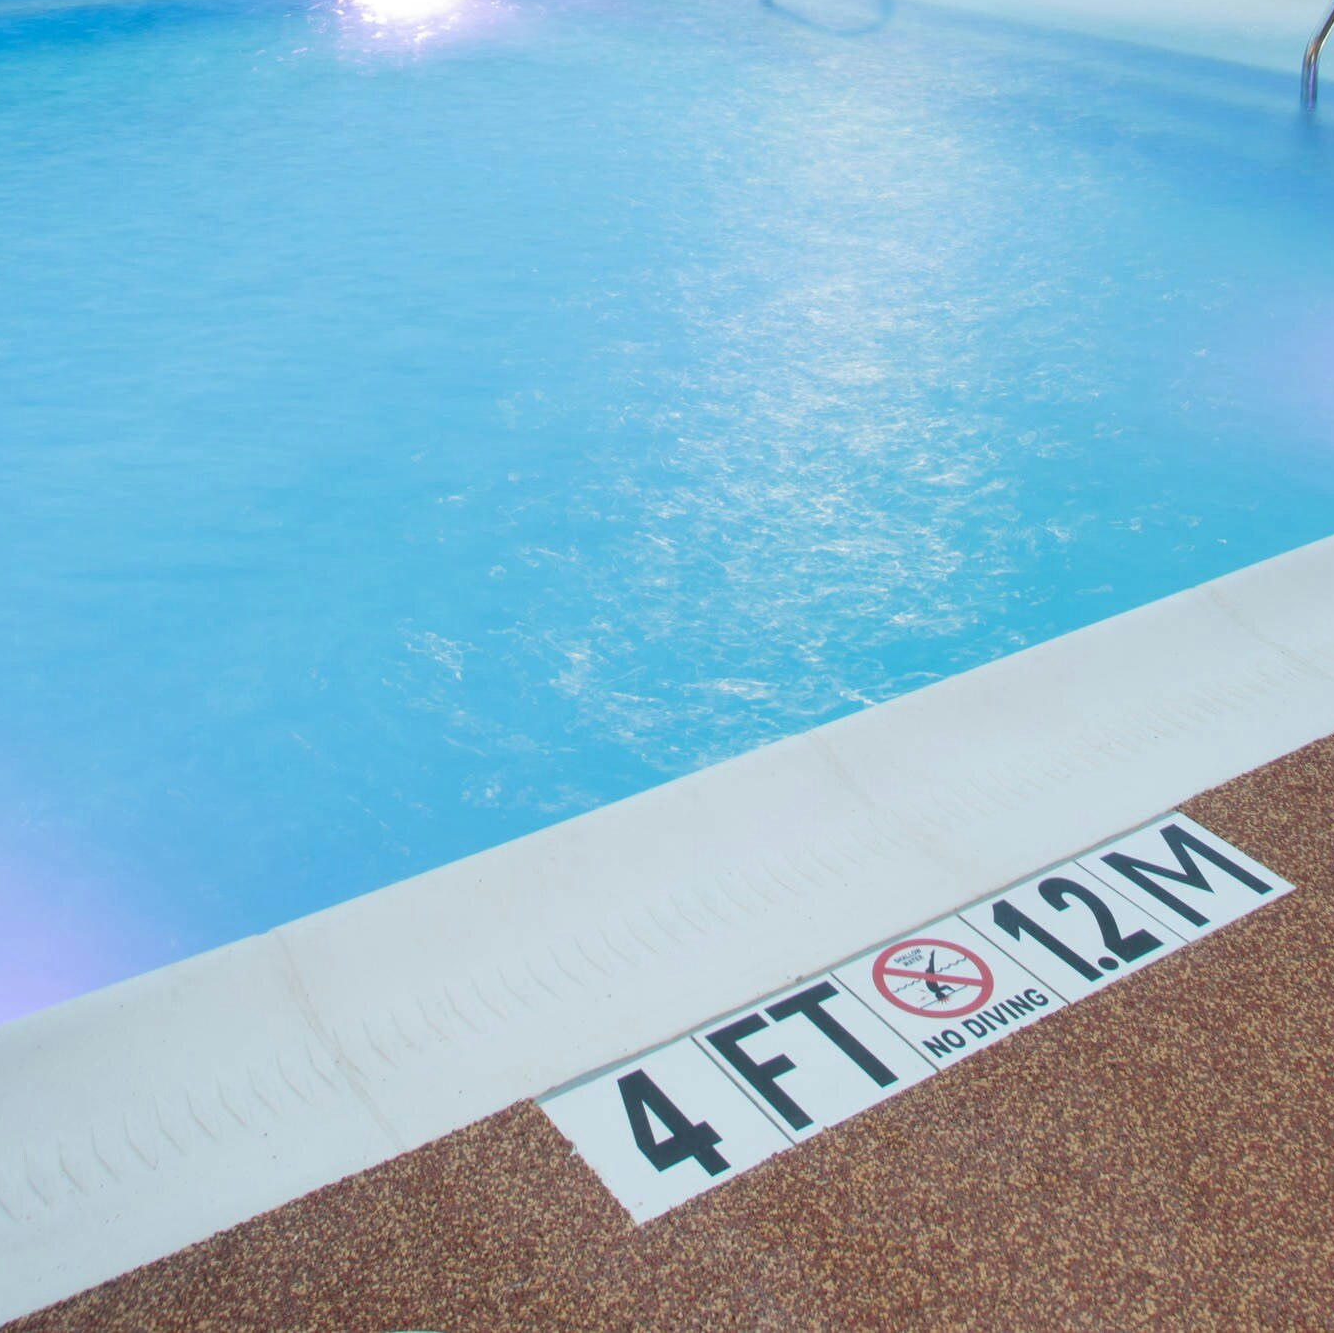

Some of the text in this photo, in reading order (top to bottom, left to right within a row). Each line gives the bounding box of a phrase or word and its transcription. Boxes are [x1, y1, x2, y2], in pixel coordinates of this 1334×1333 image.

[617, 1069, 731, 1177] 4
[705, 980, 900, 1131] FT
[1099, 823, 1275, 927] M
[922, 988, 1049, 1059] NO DIVING
